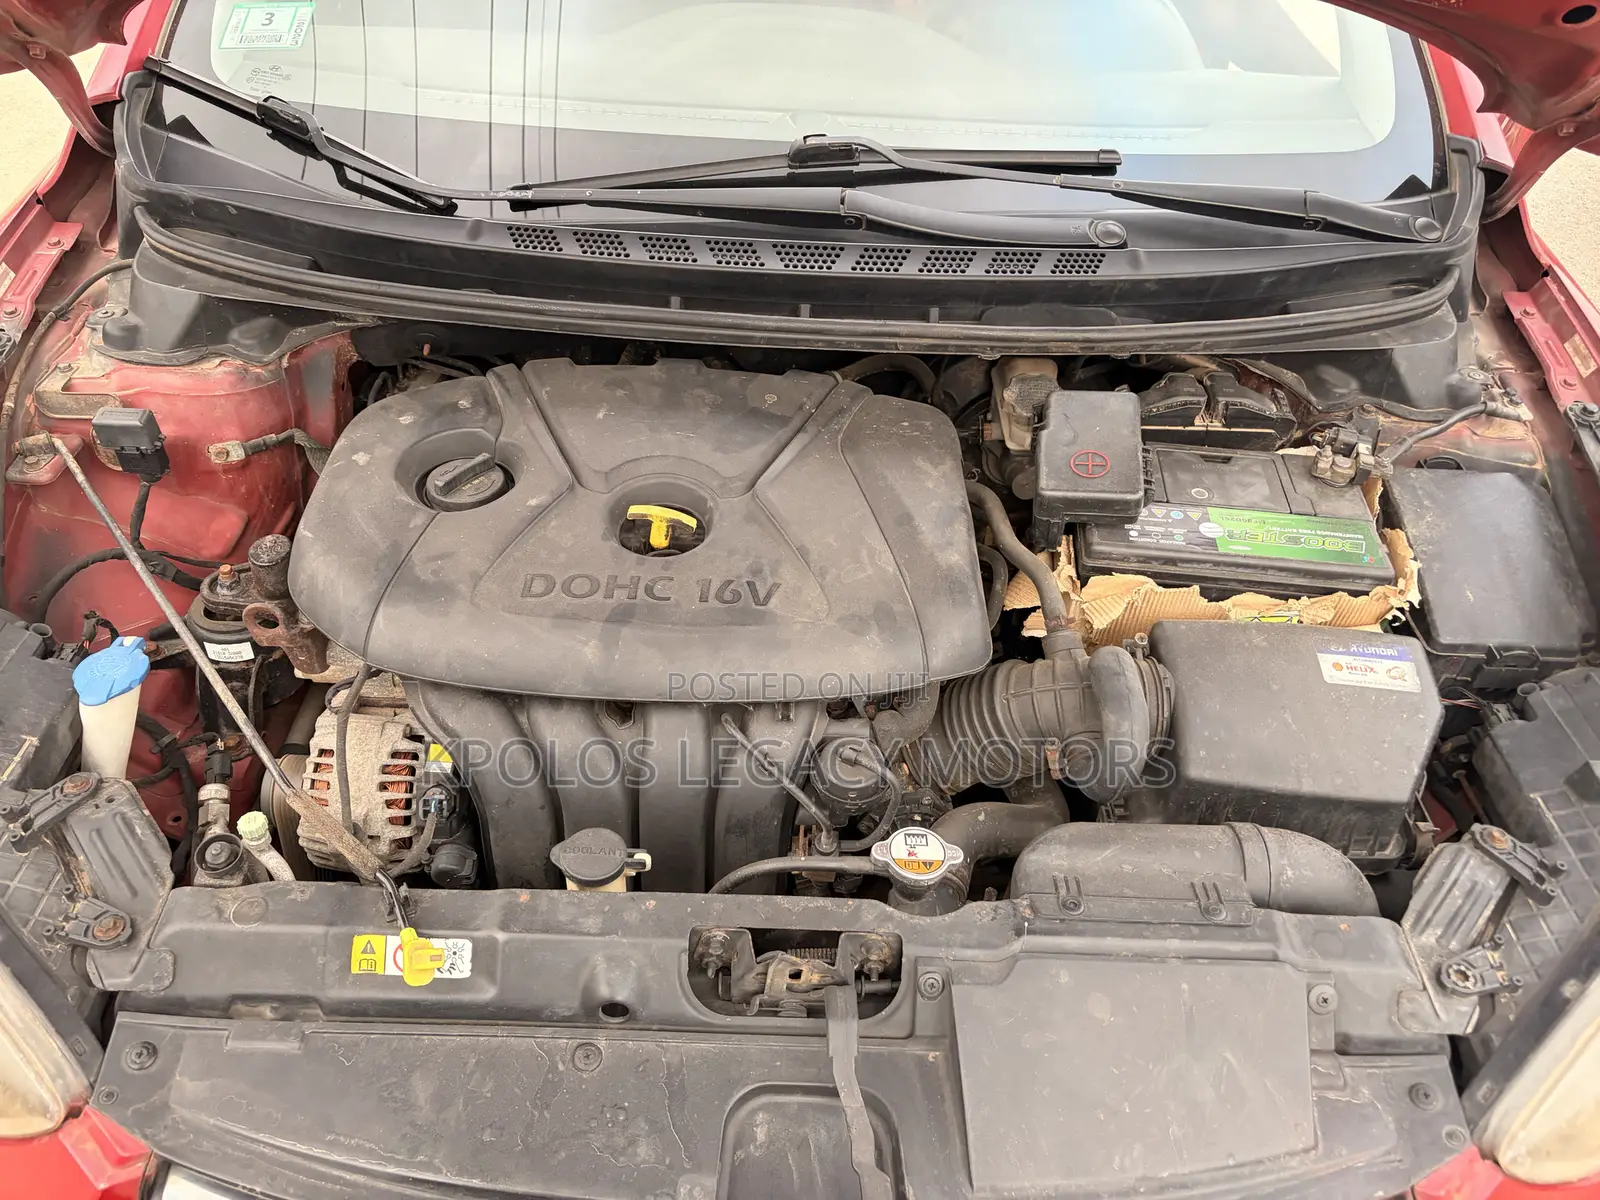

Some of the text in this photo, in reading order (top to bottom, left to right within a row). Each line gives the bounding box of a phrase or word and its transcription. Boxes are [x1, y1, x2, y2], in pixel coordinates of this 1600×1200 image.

[261, 12, 276, 26] 3
[1225, 528, 1366, 554] BOOSTER
[519, 573, 782, 607] DOHC 16V
[1350, 644, 1399, 657] HYUNDAI
[564, 846, 628, 858] COOLANT
